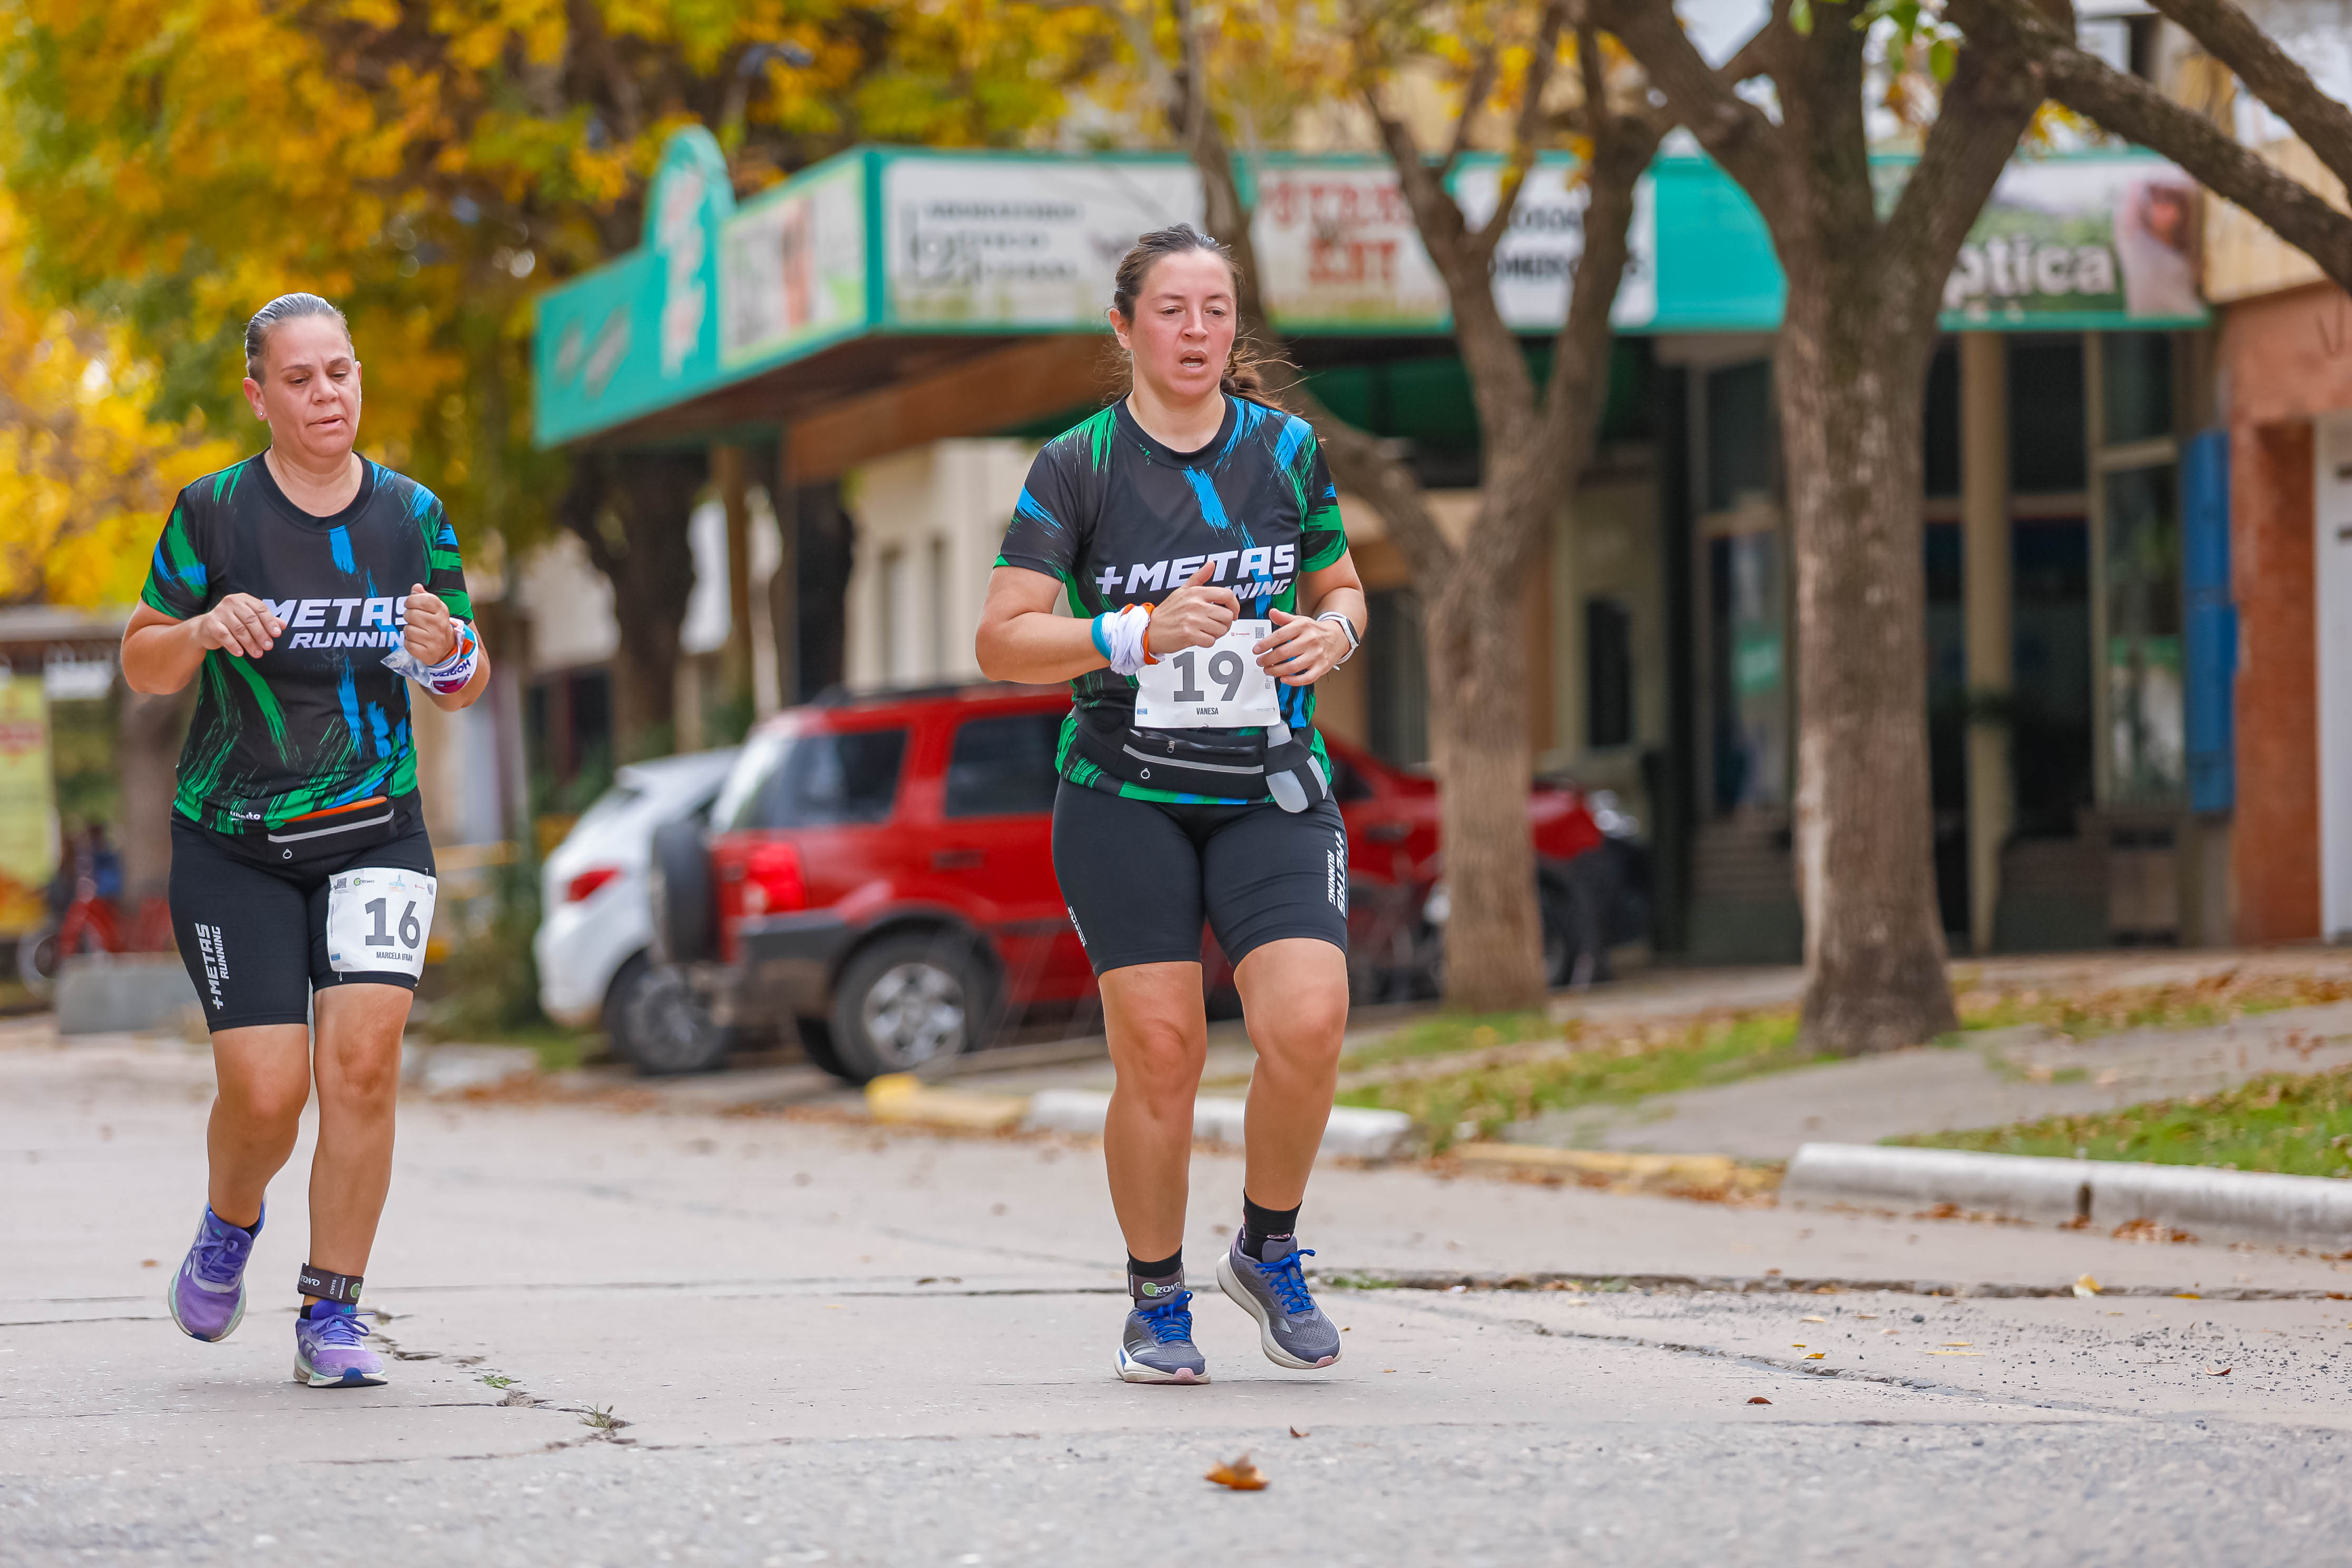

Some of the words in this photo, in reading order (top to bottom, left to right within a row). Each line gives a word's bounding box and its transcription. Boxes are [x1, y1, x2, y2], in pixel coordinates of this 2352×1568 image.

[1943, 235, 2115, 310] ptica
[1225, 578, 1291, 600] NING
[288, 631, 406, 649] RUNNIN
[1172, 650, 1244, 702] 19
[1196, 707, 1219, 716] VANESA
[1327, 849, 1336, 906] RUNNING
[365, 897, 421, 949] 16
[195, 923, 224, 1010] +METAS
[211, 926, 230, 980] RUNNING
[376, 951, 401, 960] MARCELA
